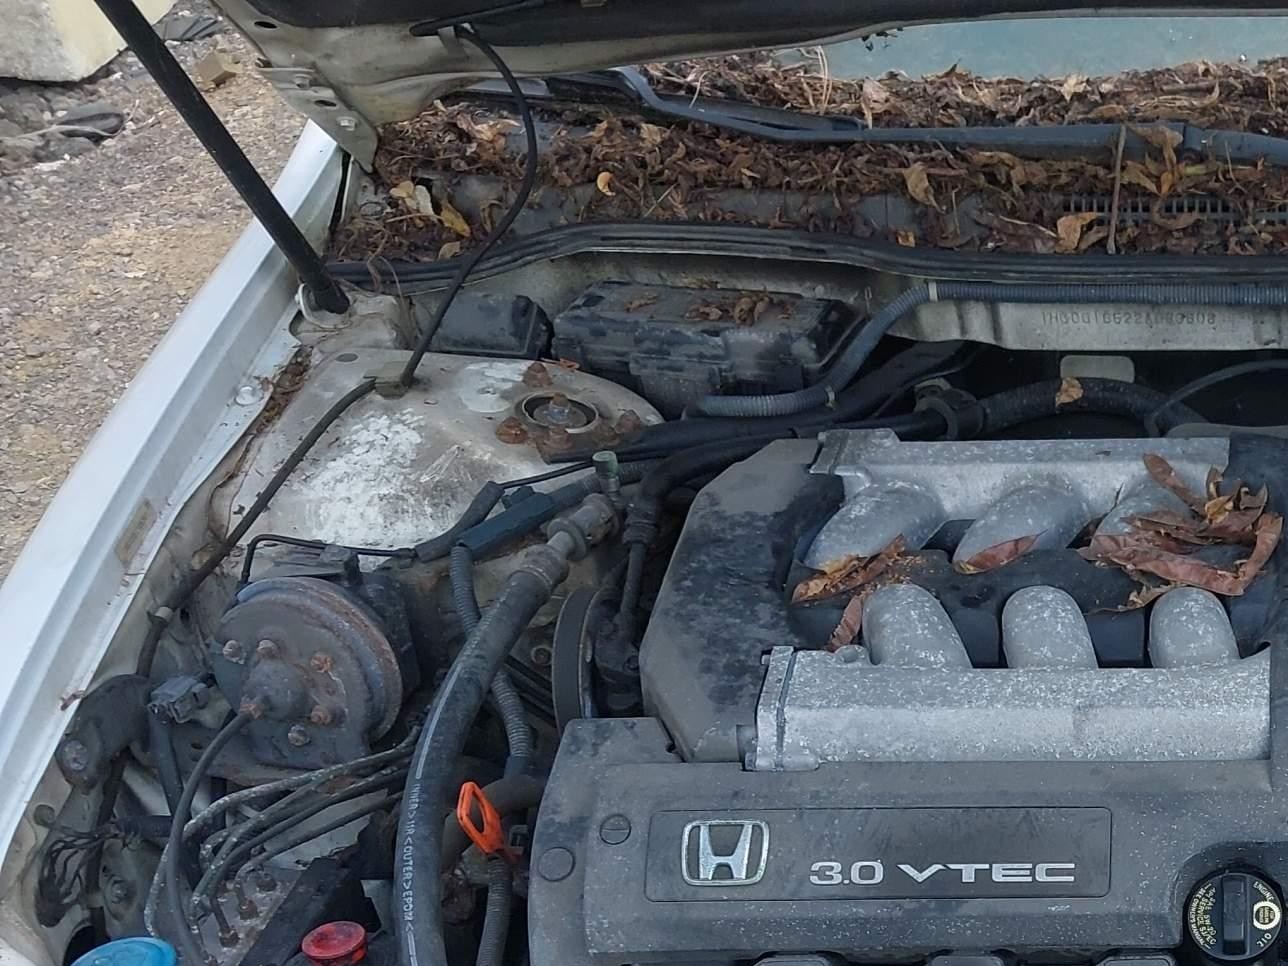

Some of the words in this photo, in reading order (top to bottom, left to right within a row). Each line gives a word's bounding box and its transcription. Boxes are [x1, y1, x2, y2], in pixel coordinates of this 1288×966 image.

[809, 860, 885, 886] 3.0
[896, 862, 1075, 884] VTEC
[1253, 881, 1274, 901] ENGINE
